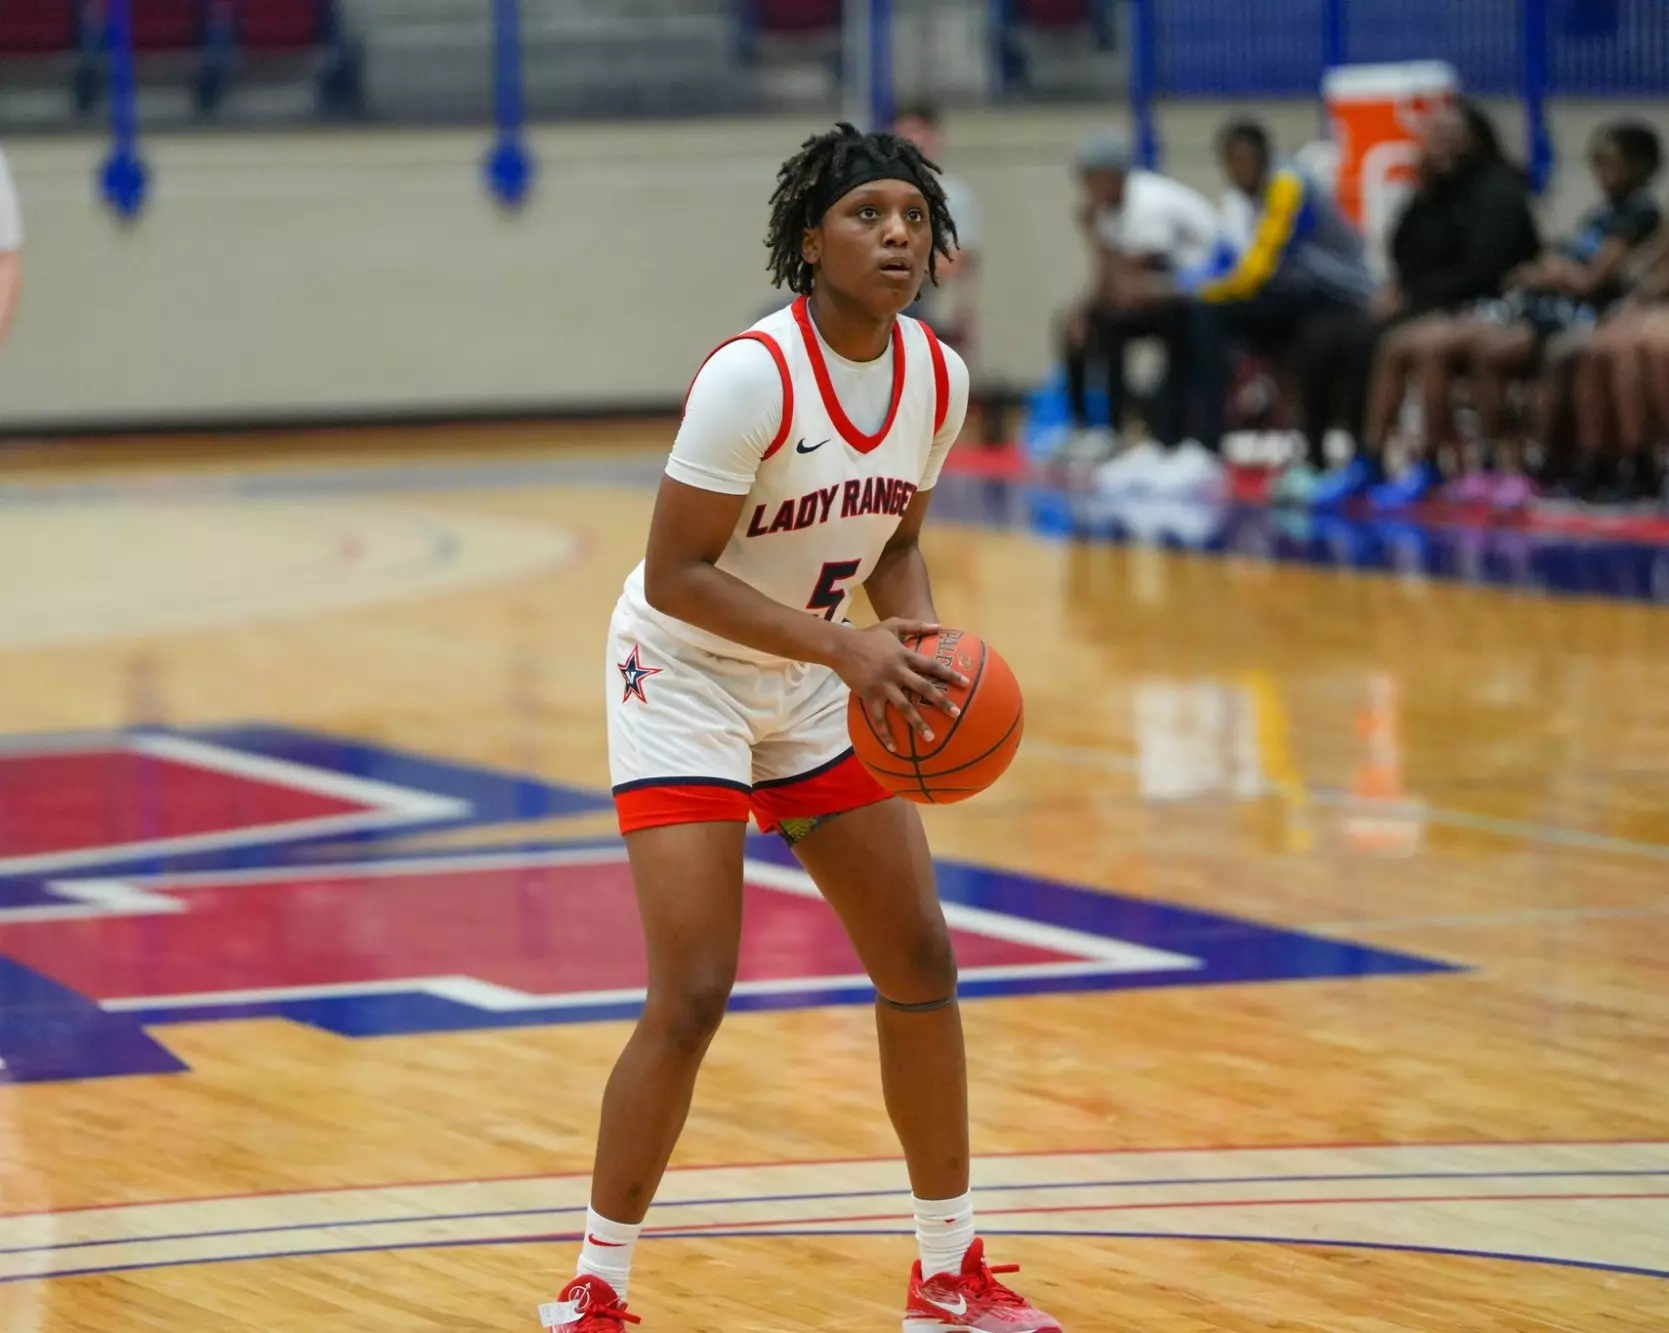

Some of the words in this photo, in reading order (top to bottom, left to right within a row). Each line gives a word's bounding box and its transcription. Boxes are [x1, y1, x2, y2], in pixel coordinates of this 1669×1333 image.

[746, 484, 839, 537] LADY
[840, 476, 917, 518] RANGE
[805, 558, 861, 622] 5
